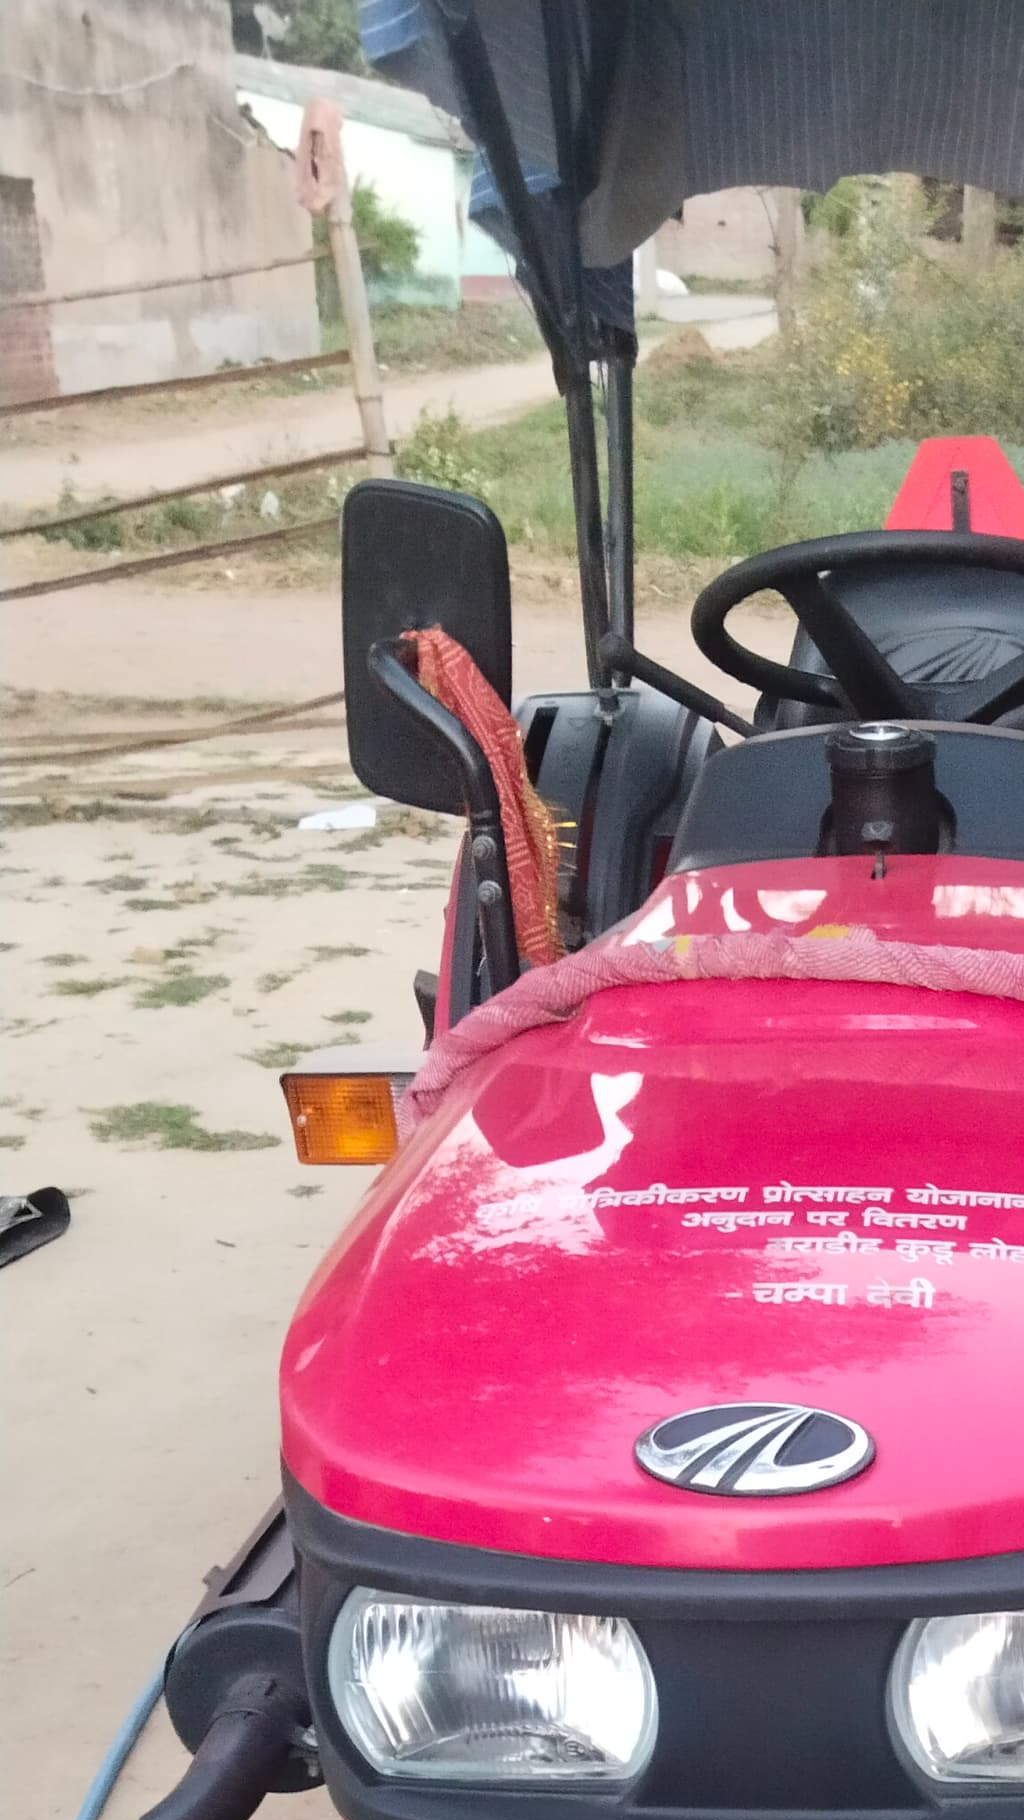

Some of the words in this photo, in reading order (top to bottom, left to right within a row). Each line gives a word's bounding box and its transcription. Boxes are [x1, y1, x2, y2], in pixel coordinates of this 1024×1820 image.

[762, 1180, 894, 1205] प्रोत्साहन
[681, 1210, 794, 1233] अनुदान
[806, 1210, 850, 1227] पर
[862, 1206, 968, 1231] वितरण
[752, 1281, 849, 1305] चम्पा
[866, 1276, 935, 1308] देवी
